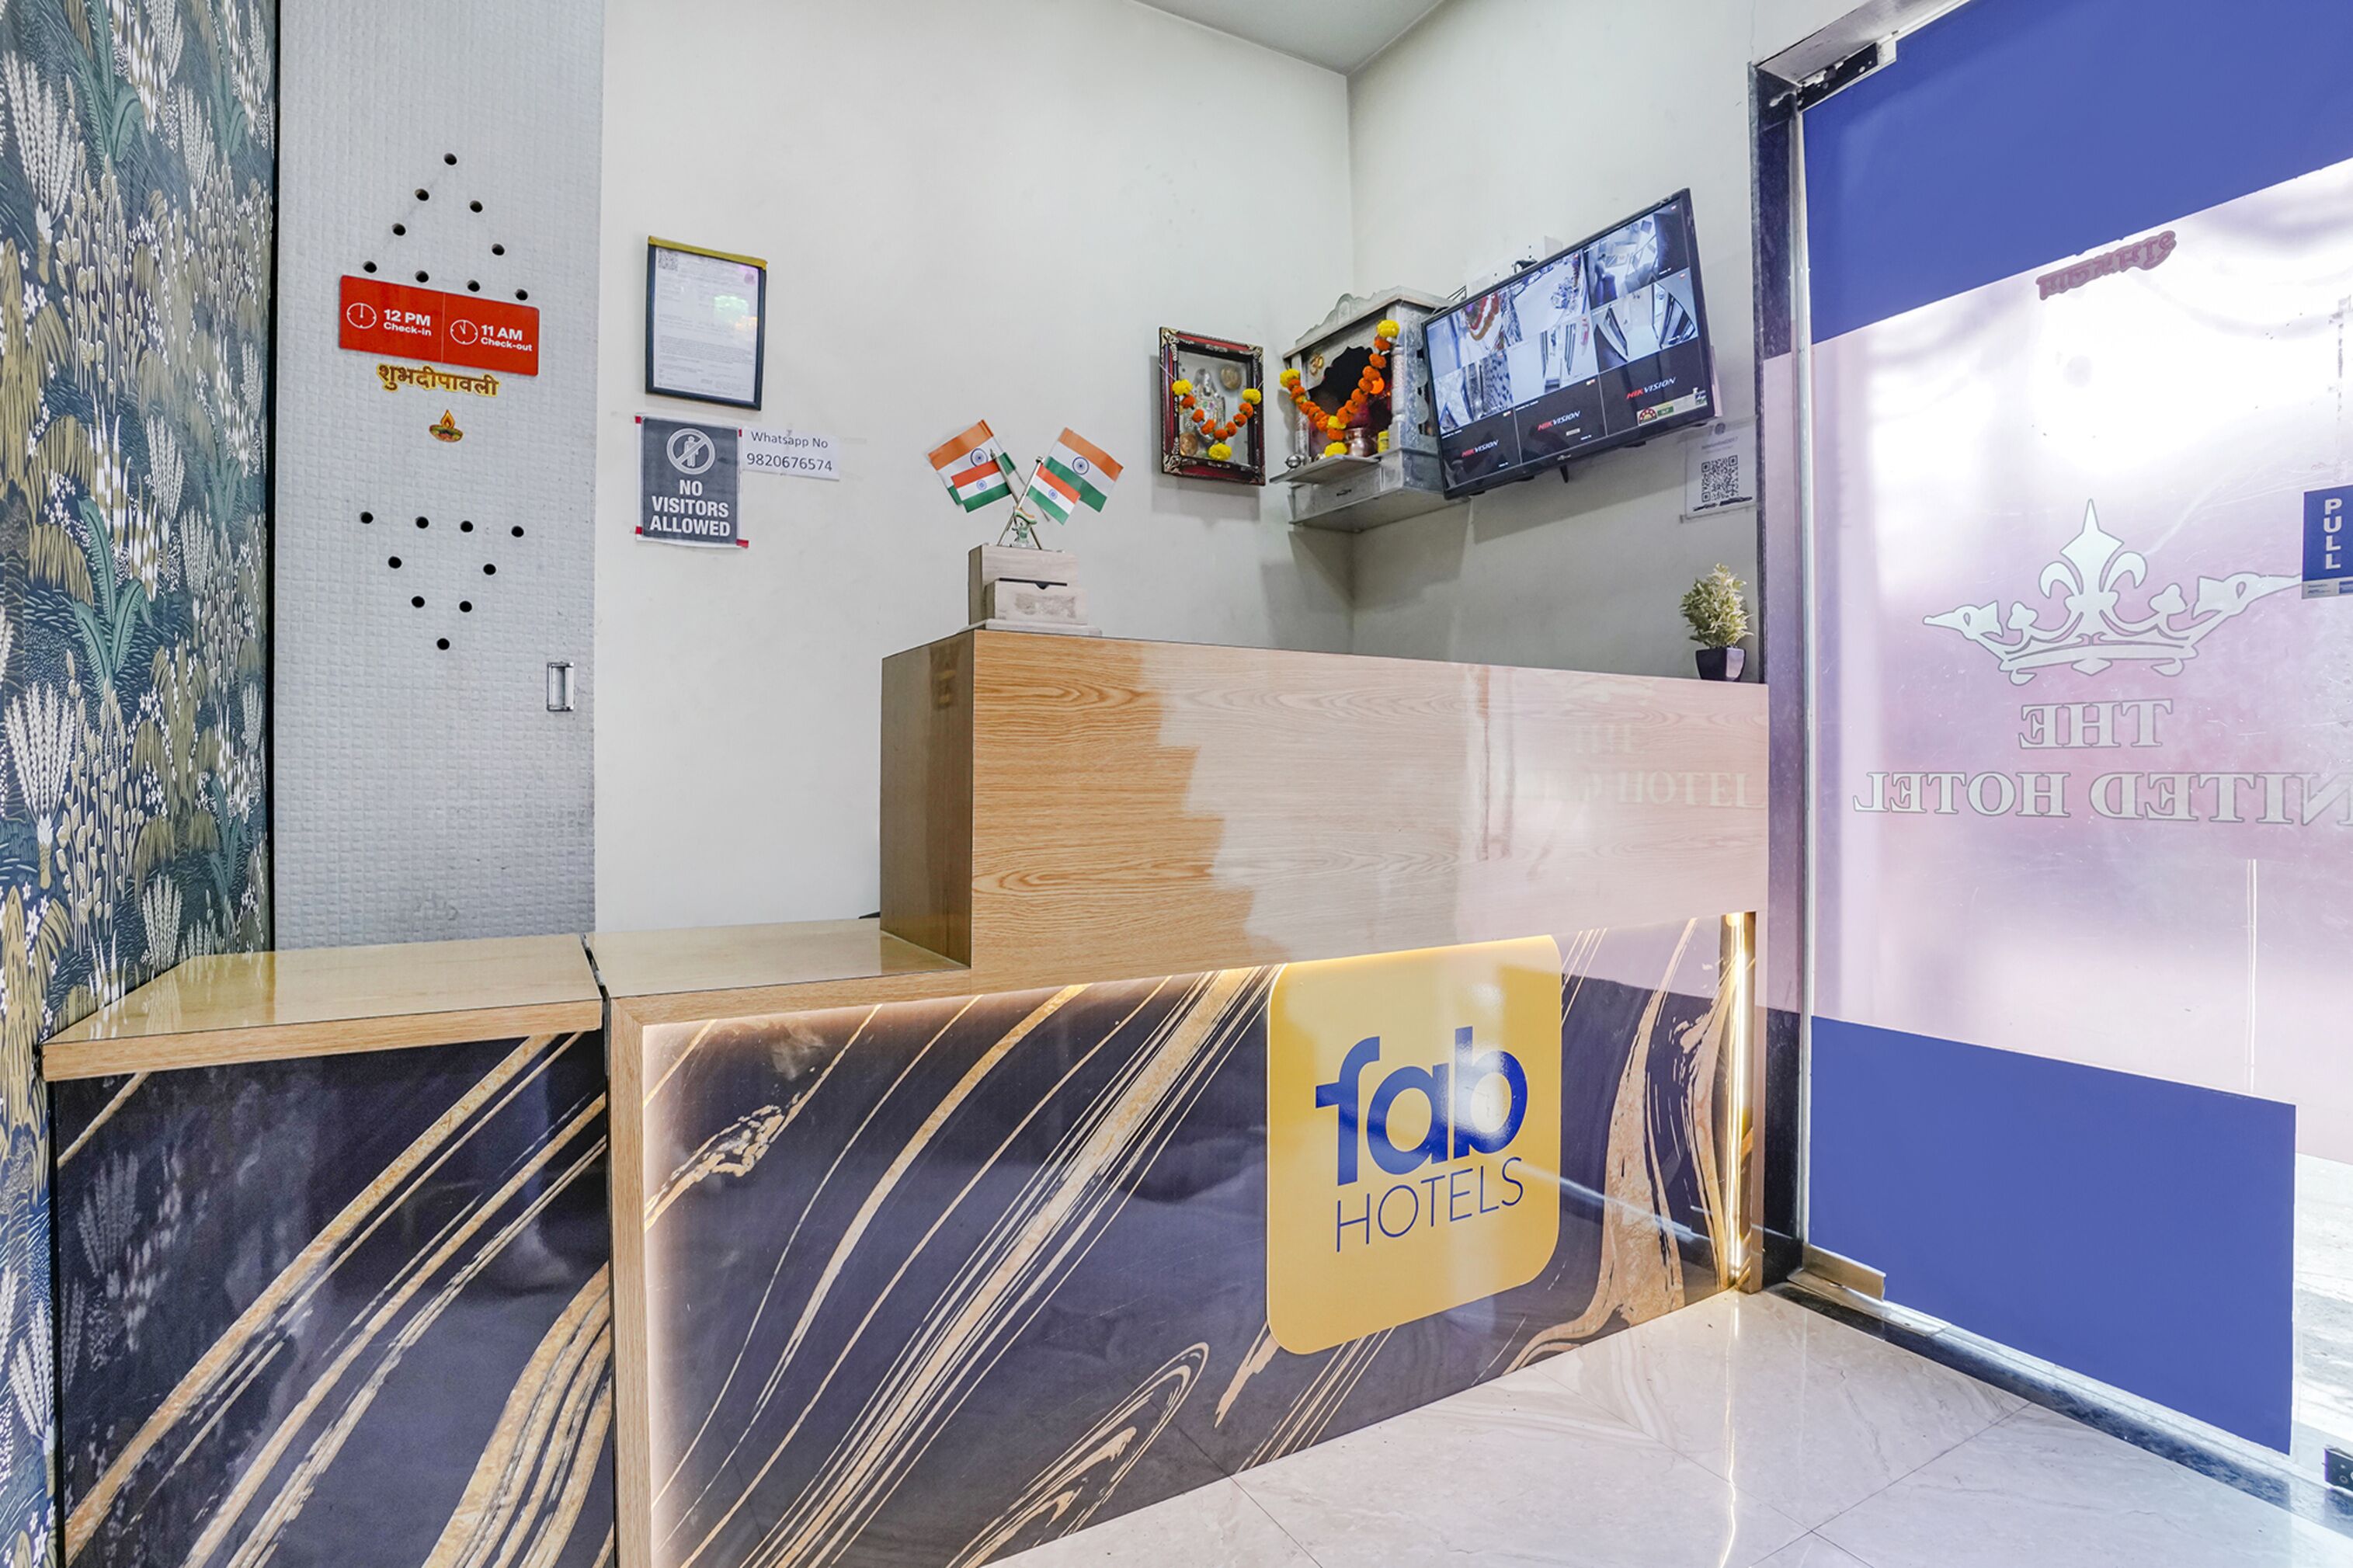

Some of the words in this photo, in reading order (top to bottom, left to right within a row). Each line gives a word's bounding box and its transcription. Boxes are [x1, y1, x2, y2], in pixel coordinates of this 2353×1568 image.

[384, 309, 401, 322] 12
[405, 311, 431, 327] PM
[384, 321, 432, 336] Check-in
[481, 325, 494, 336] 11
[497, 328, 523, 341] AM
[481, 336, 533, 352] Check-out
[751, 432, 808, 447] Whatsapp
[812, 437, 829, 448] No
[746, 452, 832, 471] 9820676574
[679, 479, 703, 496] NO
[652, 495, 729, 518] VISITORS
[649, 515, 731, 537] ALLOWED
[2323, 498, 2343, 570] PULL
[1316, 1025, 1528, 1187] fab
[1336, 1156, 1524, 1253] HOTELS
